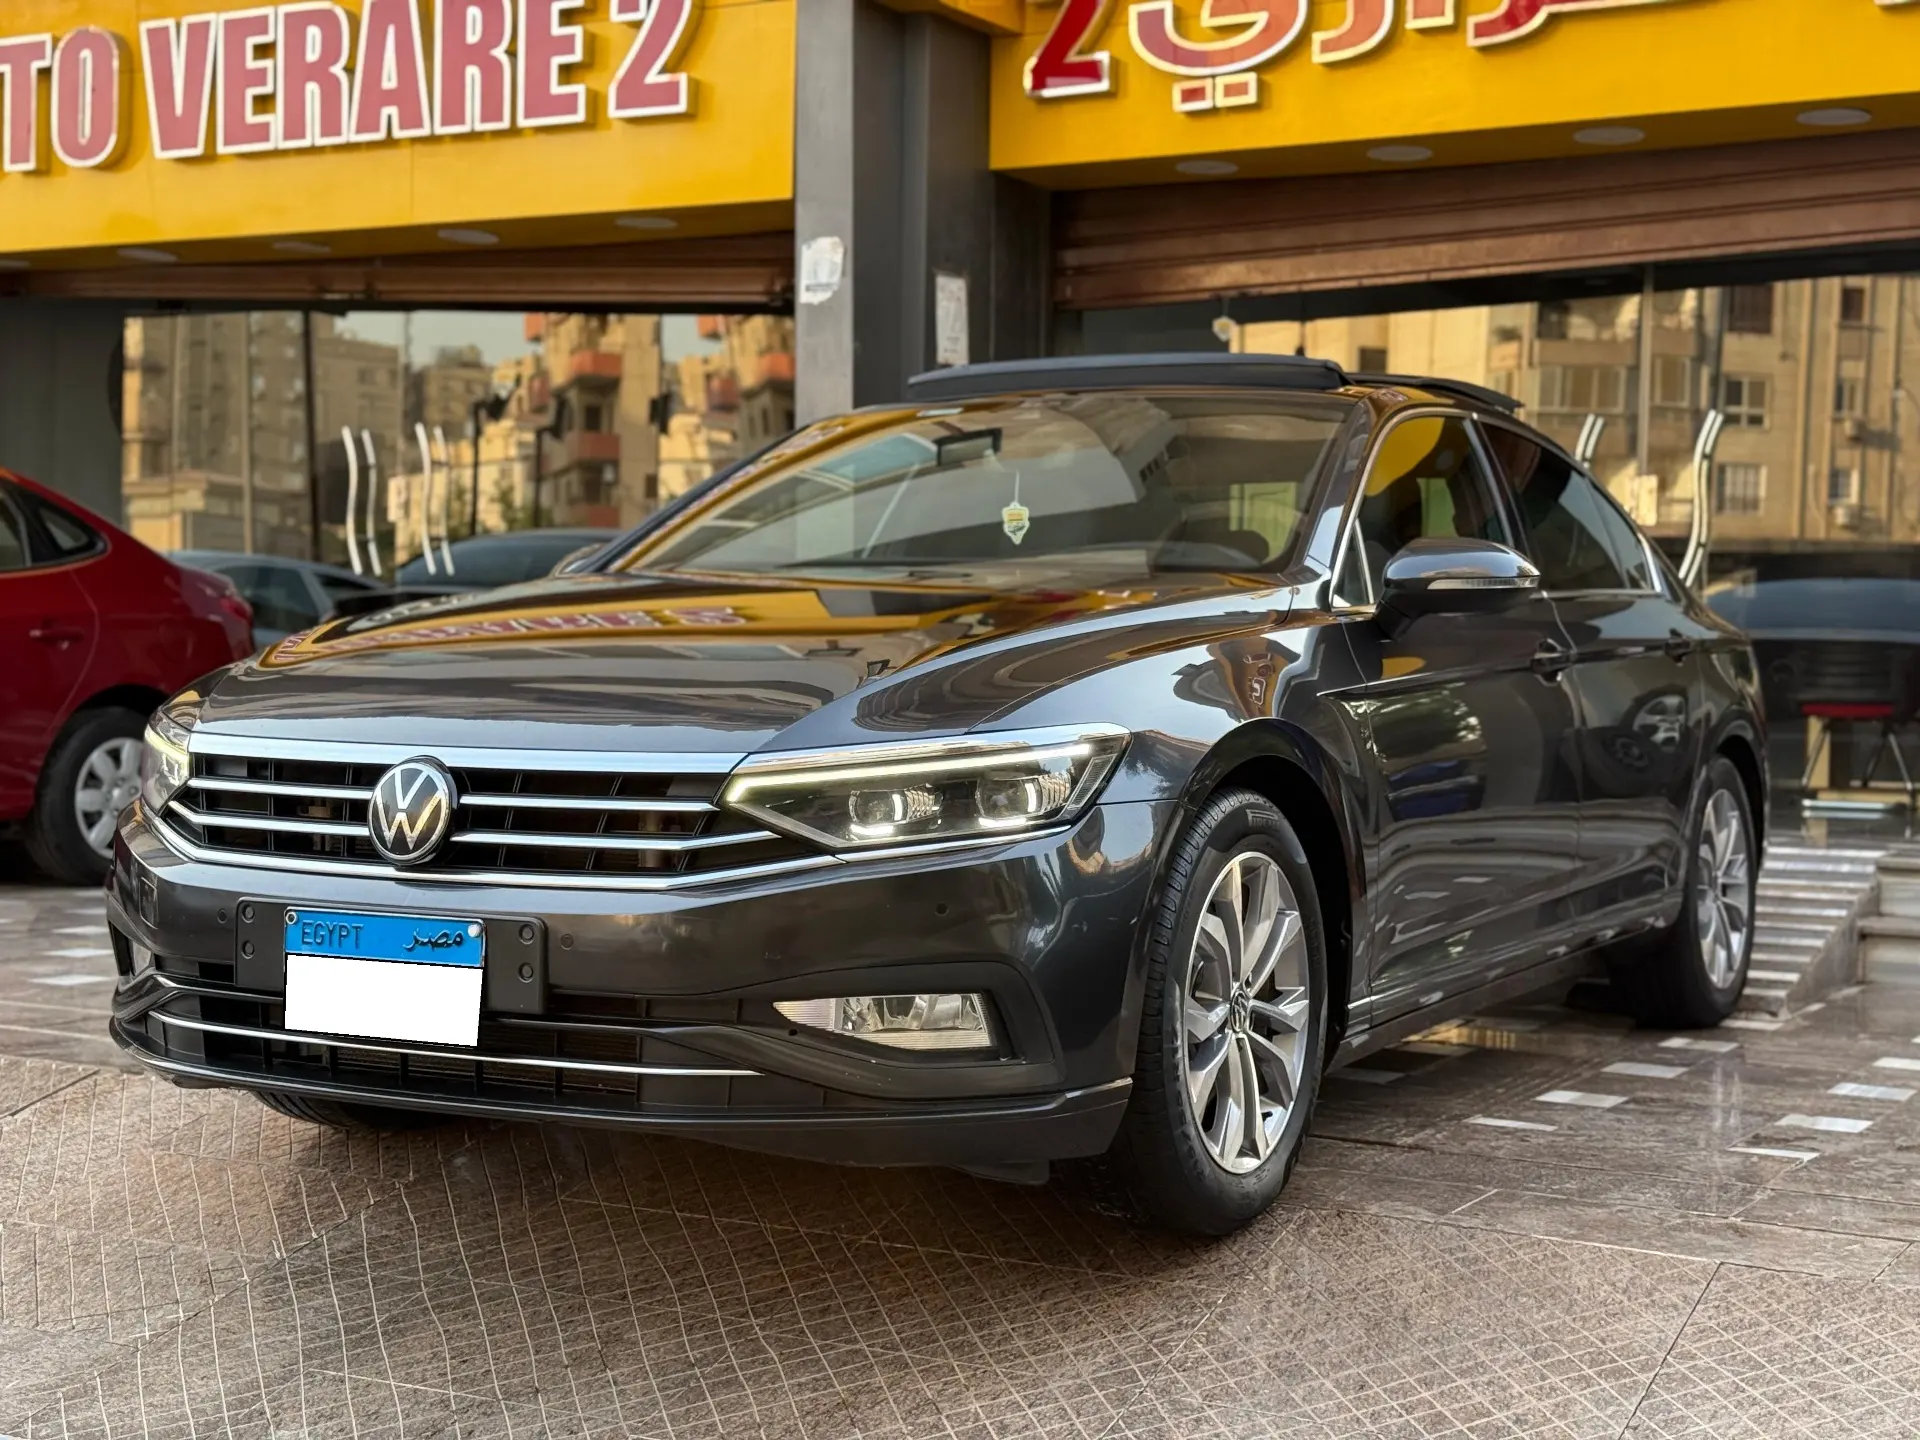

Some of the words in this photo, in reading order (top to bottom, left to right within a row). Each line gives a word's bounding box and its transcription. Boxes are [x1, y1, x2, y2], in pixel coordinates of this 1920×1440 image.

[139, 0, 587, 159] VERARE
[607, 0, 692, 118] 2
[301, 919, 364, 950] EGYPT
[402, 927, 465, 953] مصر
